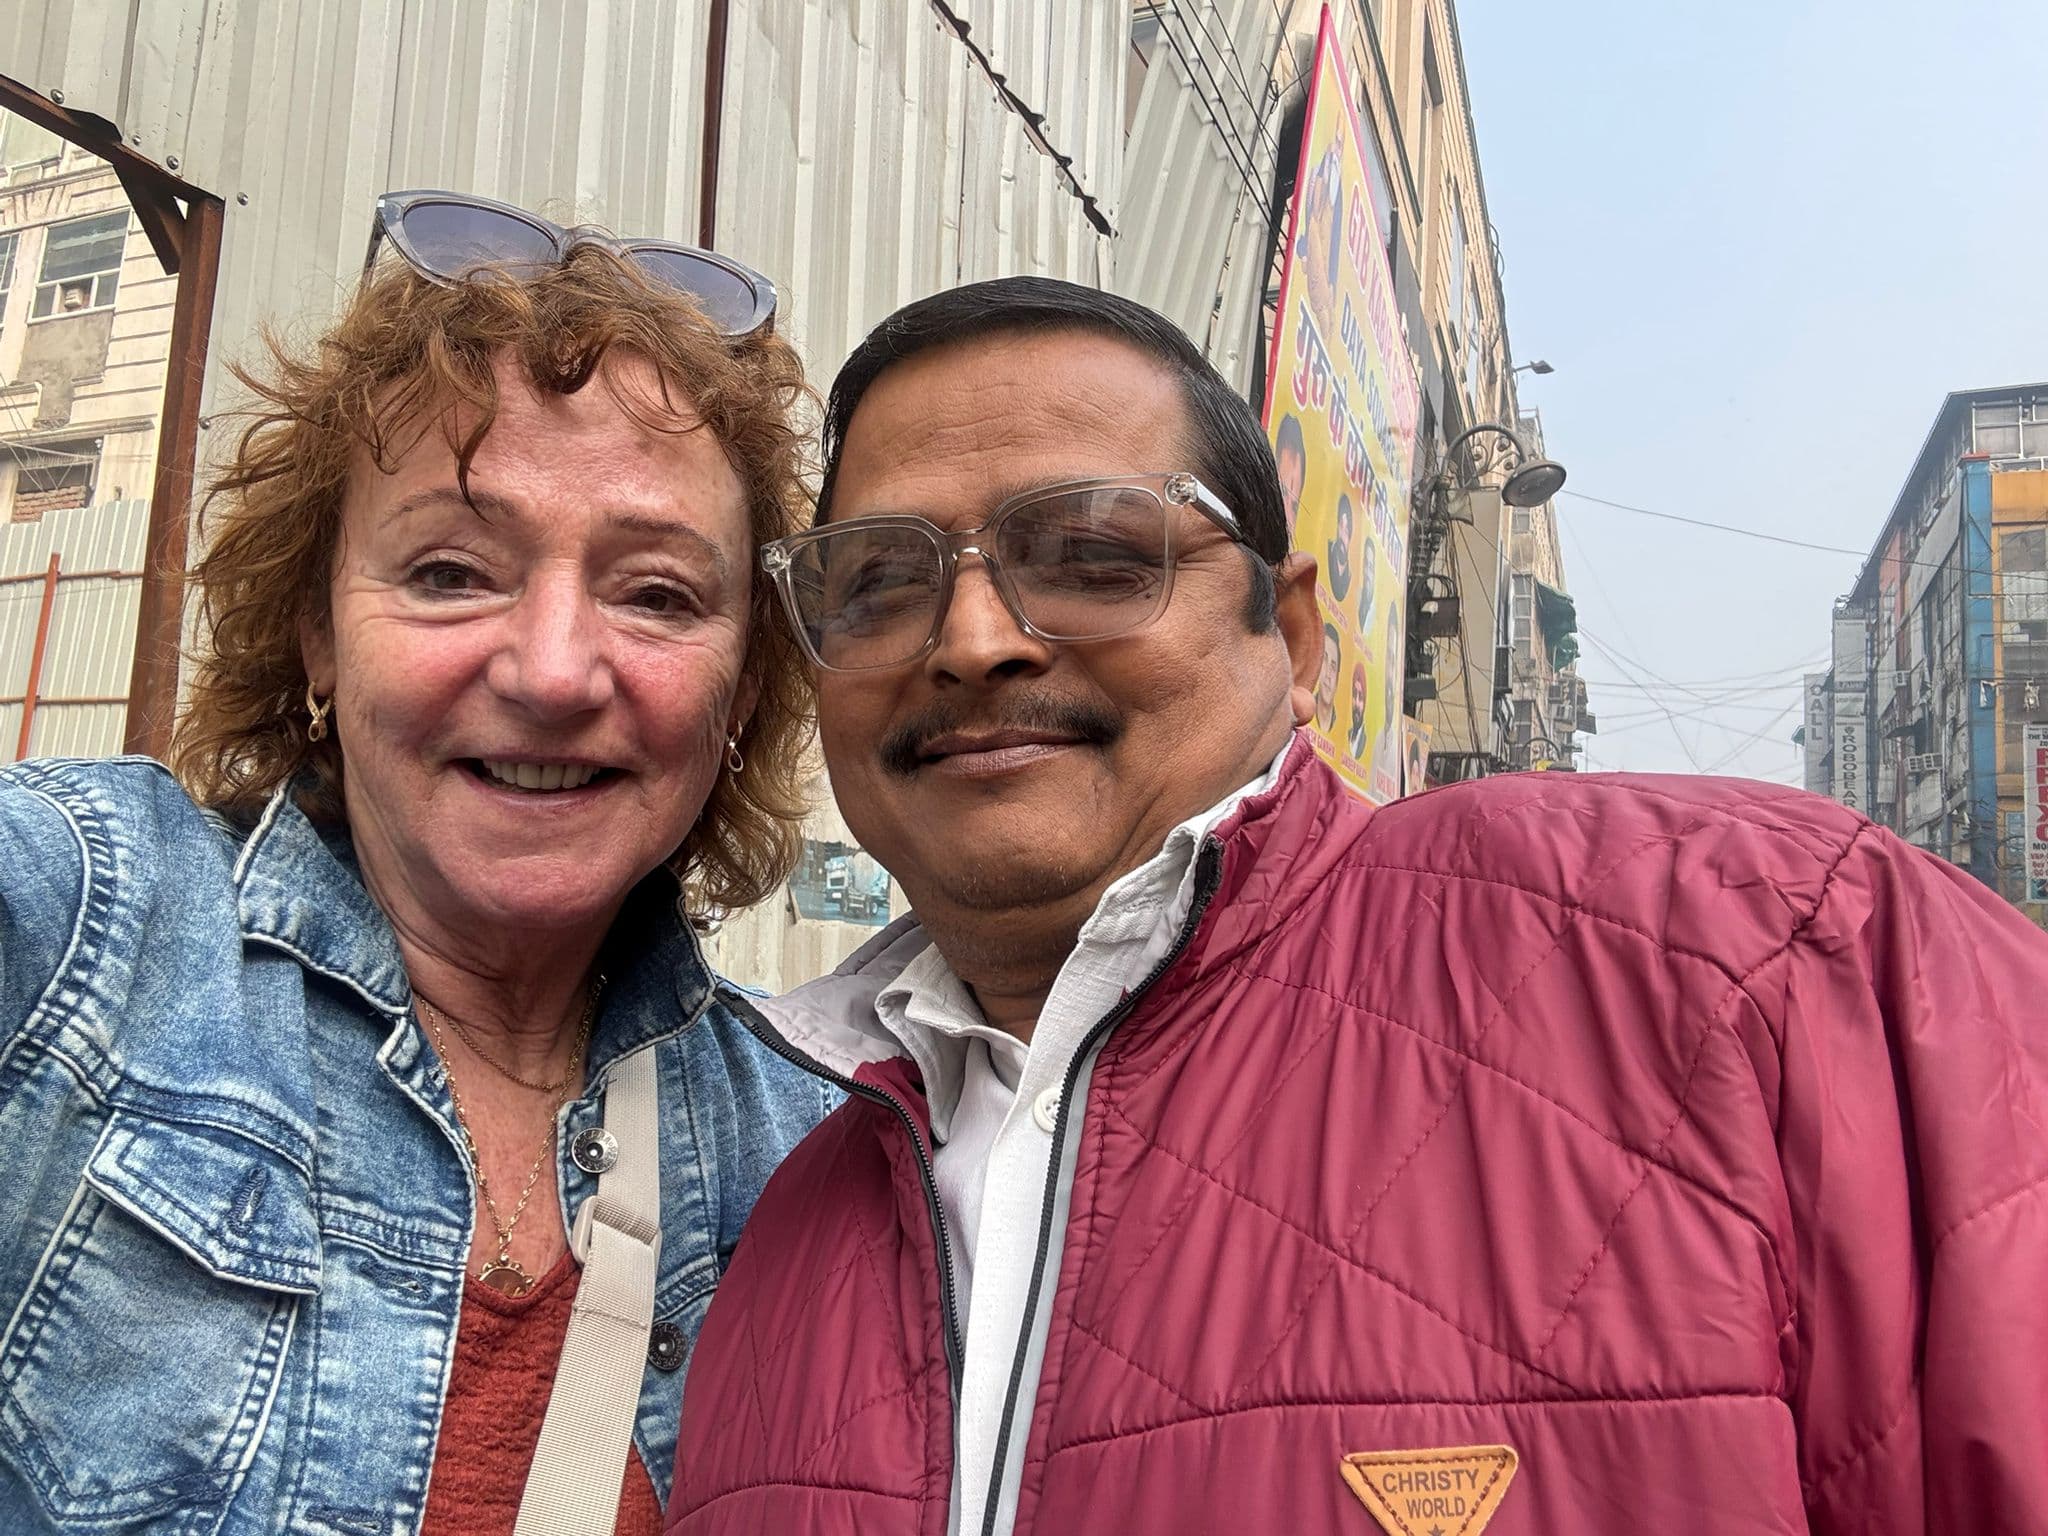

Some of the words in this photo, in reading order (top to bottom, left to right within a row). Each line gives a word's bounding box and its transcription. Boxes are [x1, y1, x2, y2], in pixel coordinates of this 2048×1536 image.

[1348, 184, 1370, 290] GTB
[1341, 291, 1366, 394] DAYA
[1330, 375, 1347, 446] के
[1345, 412, 1375, 514] लंगर
[1374, 480, 1388, 546] की
[1382, 1468, 1480, 1494] CHRISTY
[1405, 1496, 1467, 1519] WORLD
